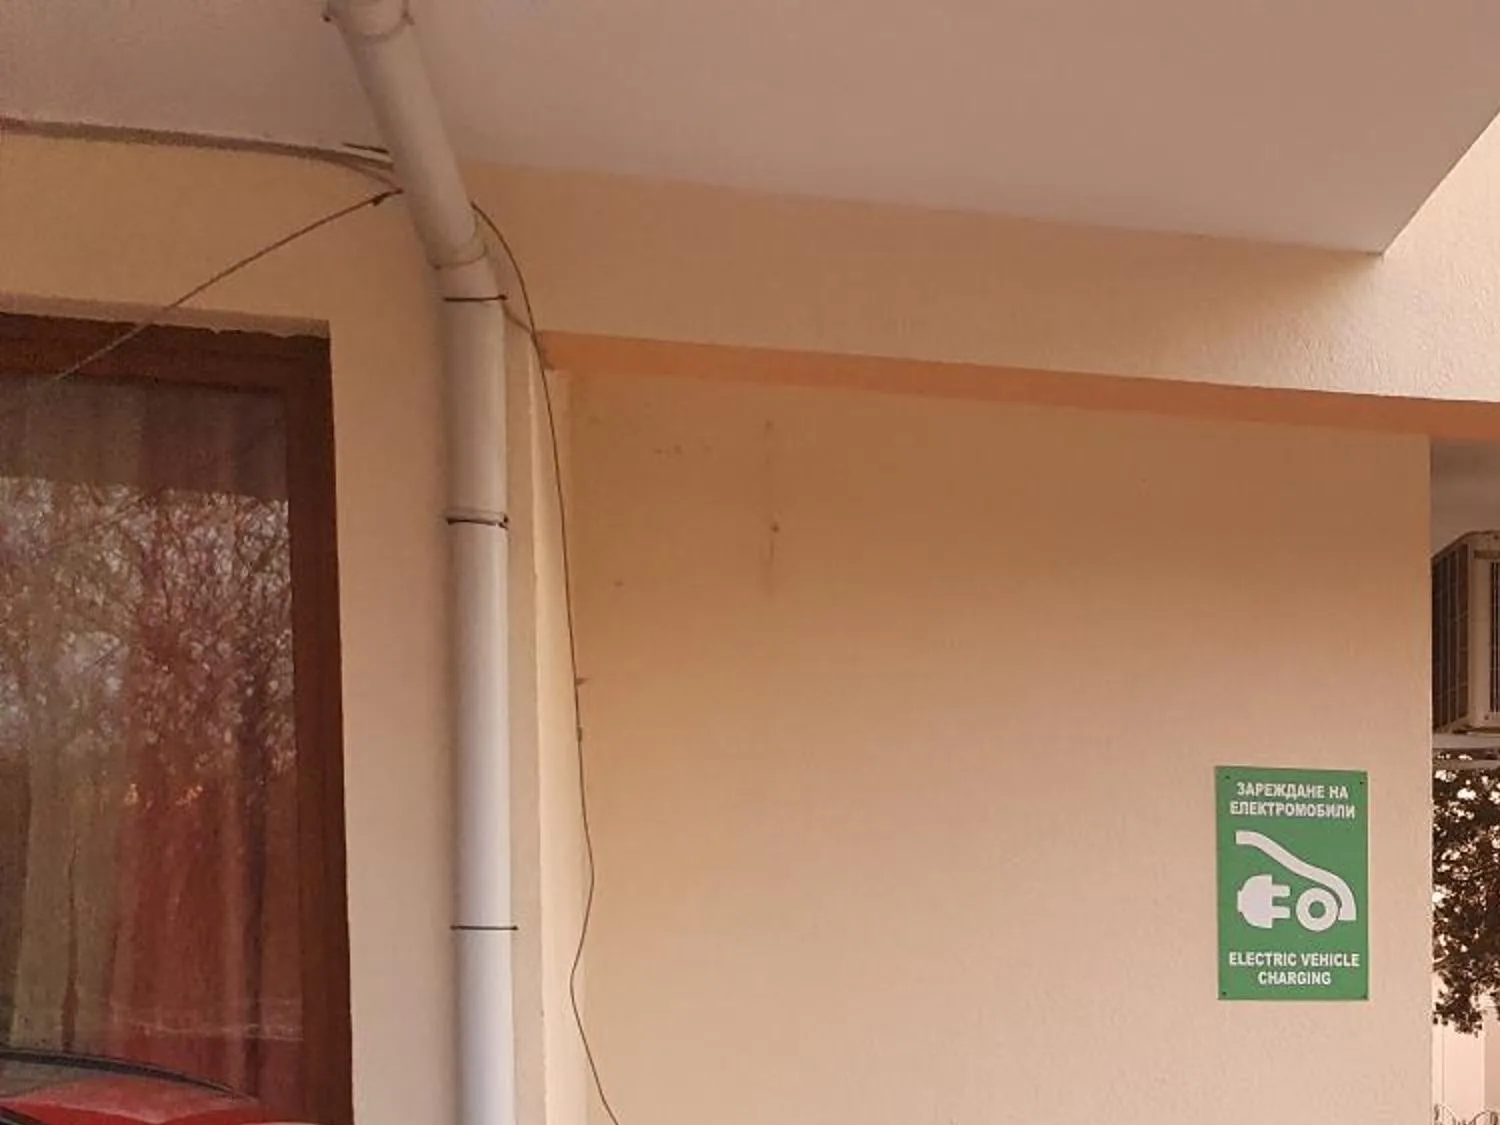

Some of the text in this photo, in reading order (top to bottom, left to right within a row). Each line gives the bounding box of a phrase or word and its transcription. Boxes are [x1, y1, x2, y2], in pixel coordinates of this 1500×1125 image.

[1236, 781, 1349, 799] ЗАРЕЖДАНЕ НА
[1229, 801, 1356, 819] ЕЛЕКТРОМОБИЛИ
[1229, 951, 1360, 967] ELECTRIC VEHICLE
[1257, 971, 1332, 986] CHARGING
